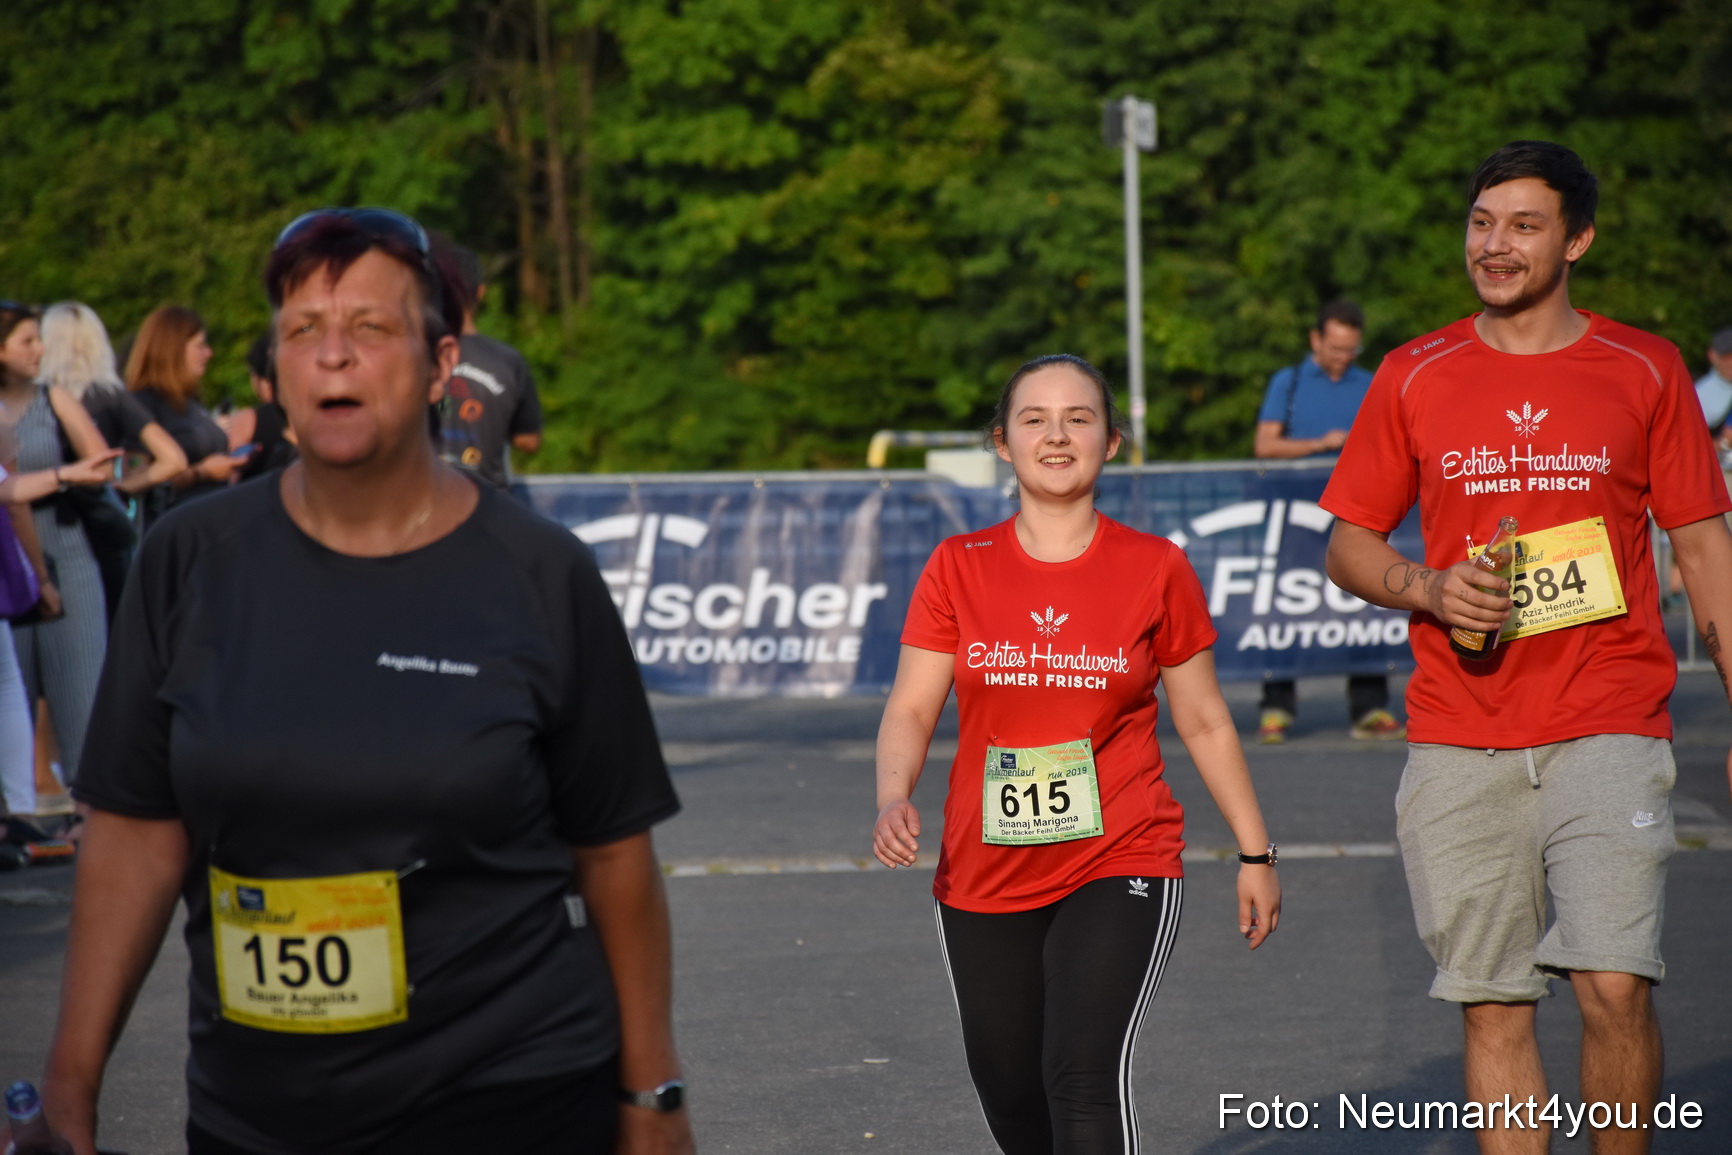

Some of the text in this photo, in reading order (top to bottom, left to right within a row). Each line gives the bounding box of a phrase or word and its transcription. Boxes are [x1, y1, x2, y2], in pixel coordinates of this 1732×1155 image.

[1423, 338, 1445, 350] JAKO
[1441, 443, 1611, 480] Echtes Handwerk
[1465, 476, 1591, 496] IMMER FRISCH
[1514, 550, 1544, 567] enlauf
[1552, 545, 1602, 562] walk 2019
[1209, 555, 1396, 617] Fisc
[1512, 560, 1587, 609] 584
[1521, 597, 1586, 619] Aziz Hendrik
[1529, 615, 1553, 626] Bäcker
[1554, 611, 1572, 619] Feihl
[1573, 605, 1596, 615] GmbH
[1237, 617, 1409, 652] AUTOMO
[632, 636, 863, 665] UTOMOBILE
[967, 640, 1130, 674] Echtes Handwerk
[376, 651, 437, 672] Angelika
[985, 672, 1107, 690] IMMER FRISCH
[1047, 766, 1088, 780] run 2019
[1001, 780, 1071, 818] 615
[998, 815, 1079, 829] Sinanaj Marigona
[1012, 828, 1035, 836] Bäcker
[1036, 827, 1053, 835] Feihl
[1054, 824, 1076, 833] GmbH
[1129, 889, 1148, 898] adidas
[243, 933, 352, 989] 150
[289, 989, 359, 1008] Angelika
